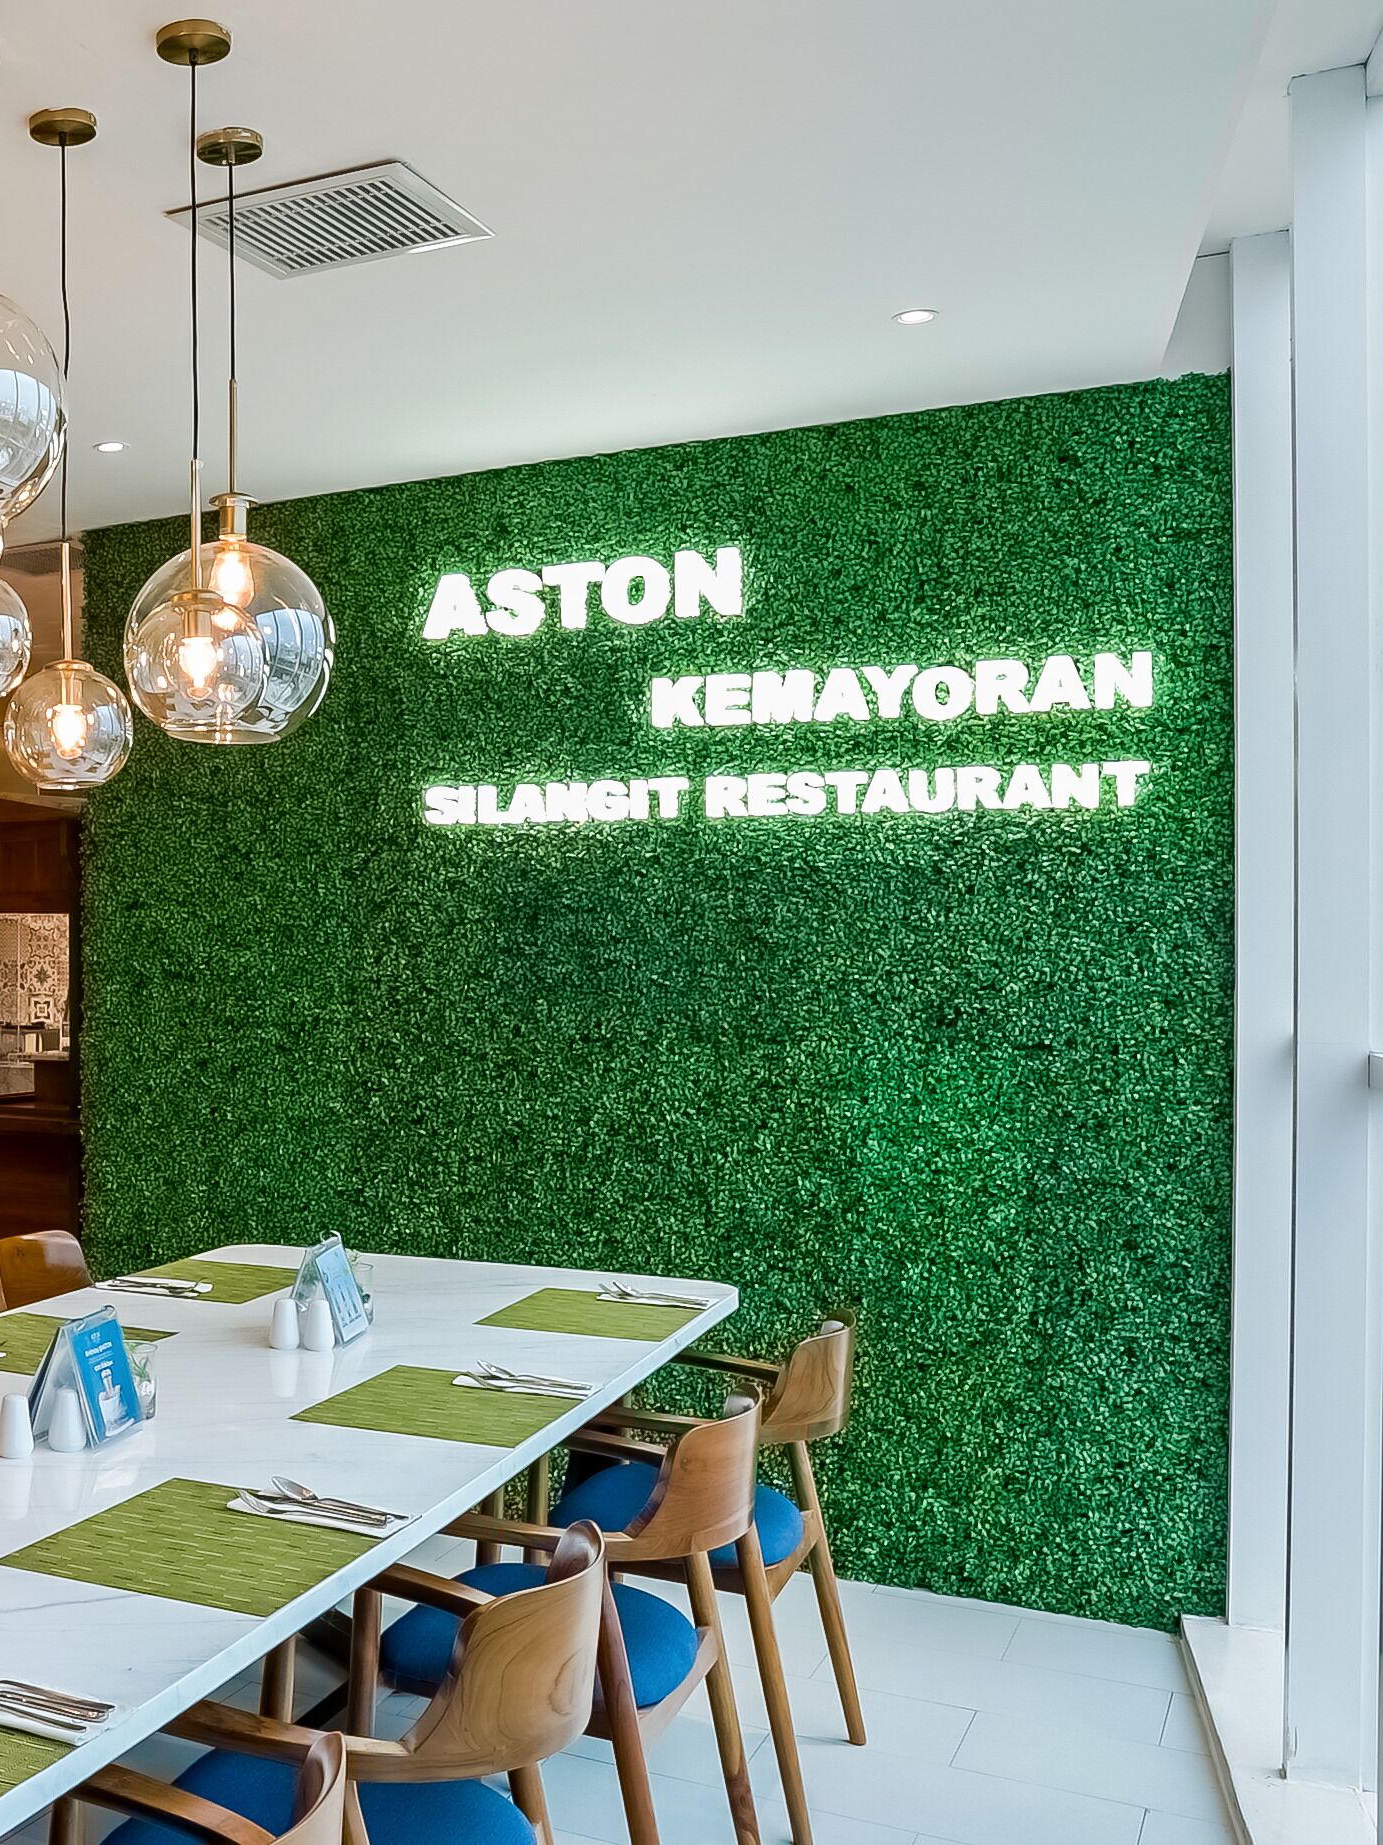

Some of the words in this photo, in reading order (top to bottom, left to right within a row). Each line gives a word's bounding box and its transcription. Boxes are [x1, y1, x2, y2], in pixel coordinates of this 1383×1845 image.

[422, 546, 743, 640] ASTON
[651, 651, 1153, 729] KEMAYORAN
[424, 776, 690, 825] SILANGIT
[705, 760, 1152, 818] RESTAURANT
